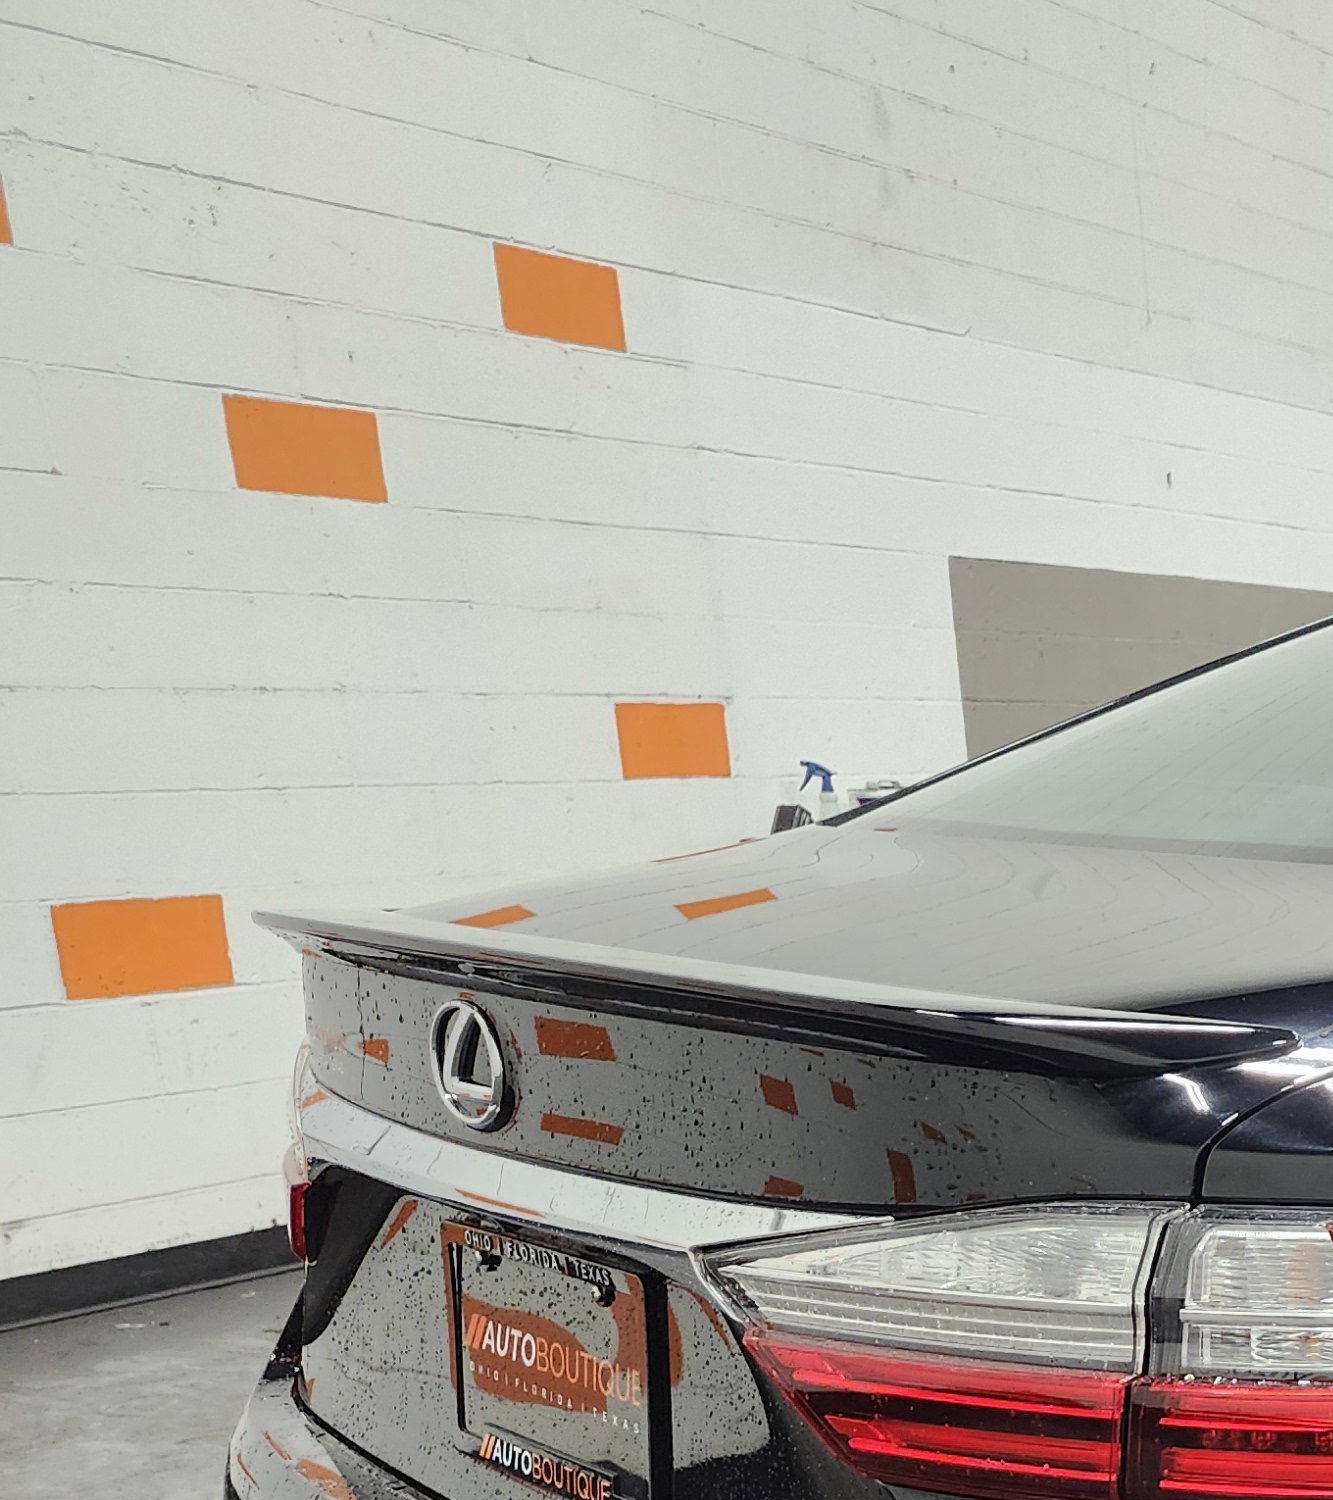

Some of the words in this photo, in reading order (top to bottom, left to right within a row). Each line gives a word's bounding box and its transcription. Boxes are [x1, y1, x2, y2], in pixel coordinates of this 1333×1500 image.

[464, 1229, 492, 1251] OHIO
[507, 1241, 562, 1272] FLORIDA
[574, 1259, 611, 1286] TEXAS
[469, 1360, 499, 1382] OHIO
[515, 1378, 573, 1410] FLORIDA
[593, 1406, 639, 1434] TEXAS
[482, 1320, 641, 1406] AUTOBOUTIQUE
